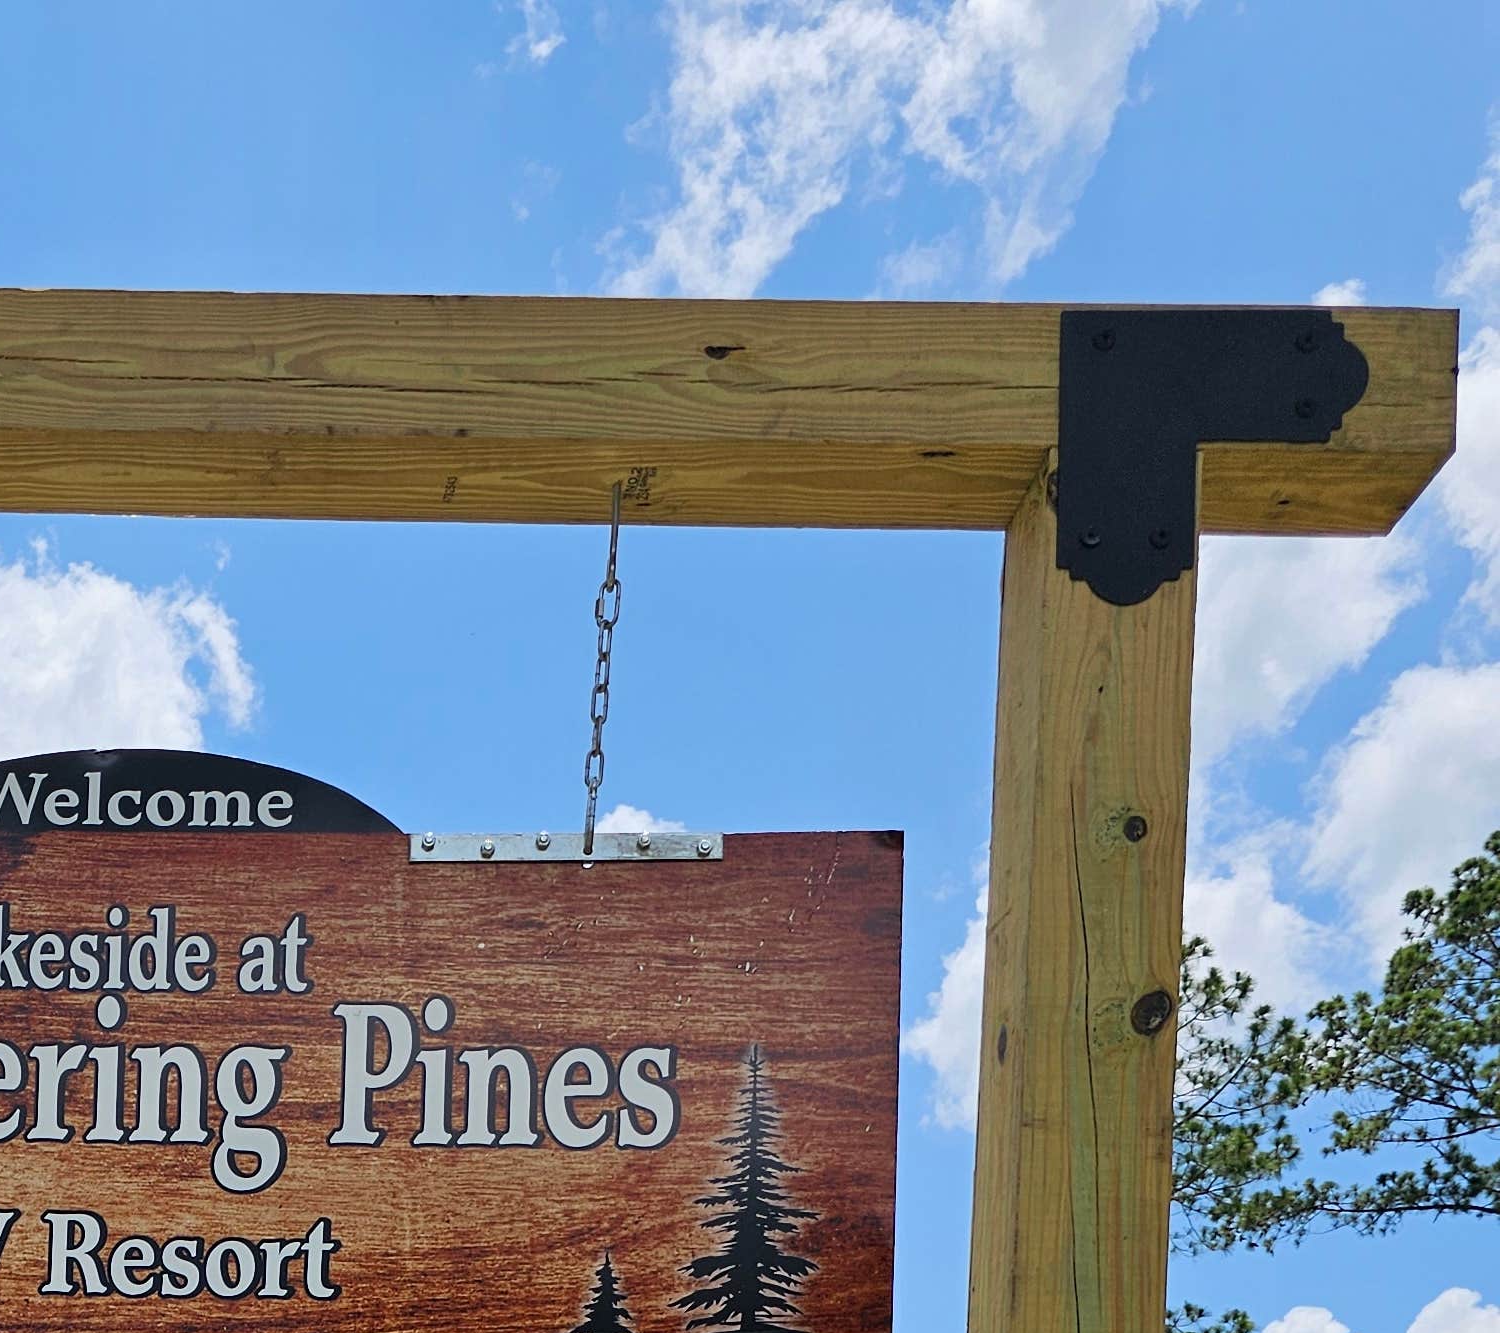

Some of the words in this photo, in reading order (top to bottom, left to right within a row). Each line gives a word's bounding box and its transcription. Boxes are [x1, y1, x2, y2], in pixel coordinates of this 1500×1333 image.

[237, 915, 310, 994] at
[327, 997, 676, 1150] Pines
[40, 1211, 337, 1300] Resort
